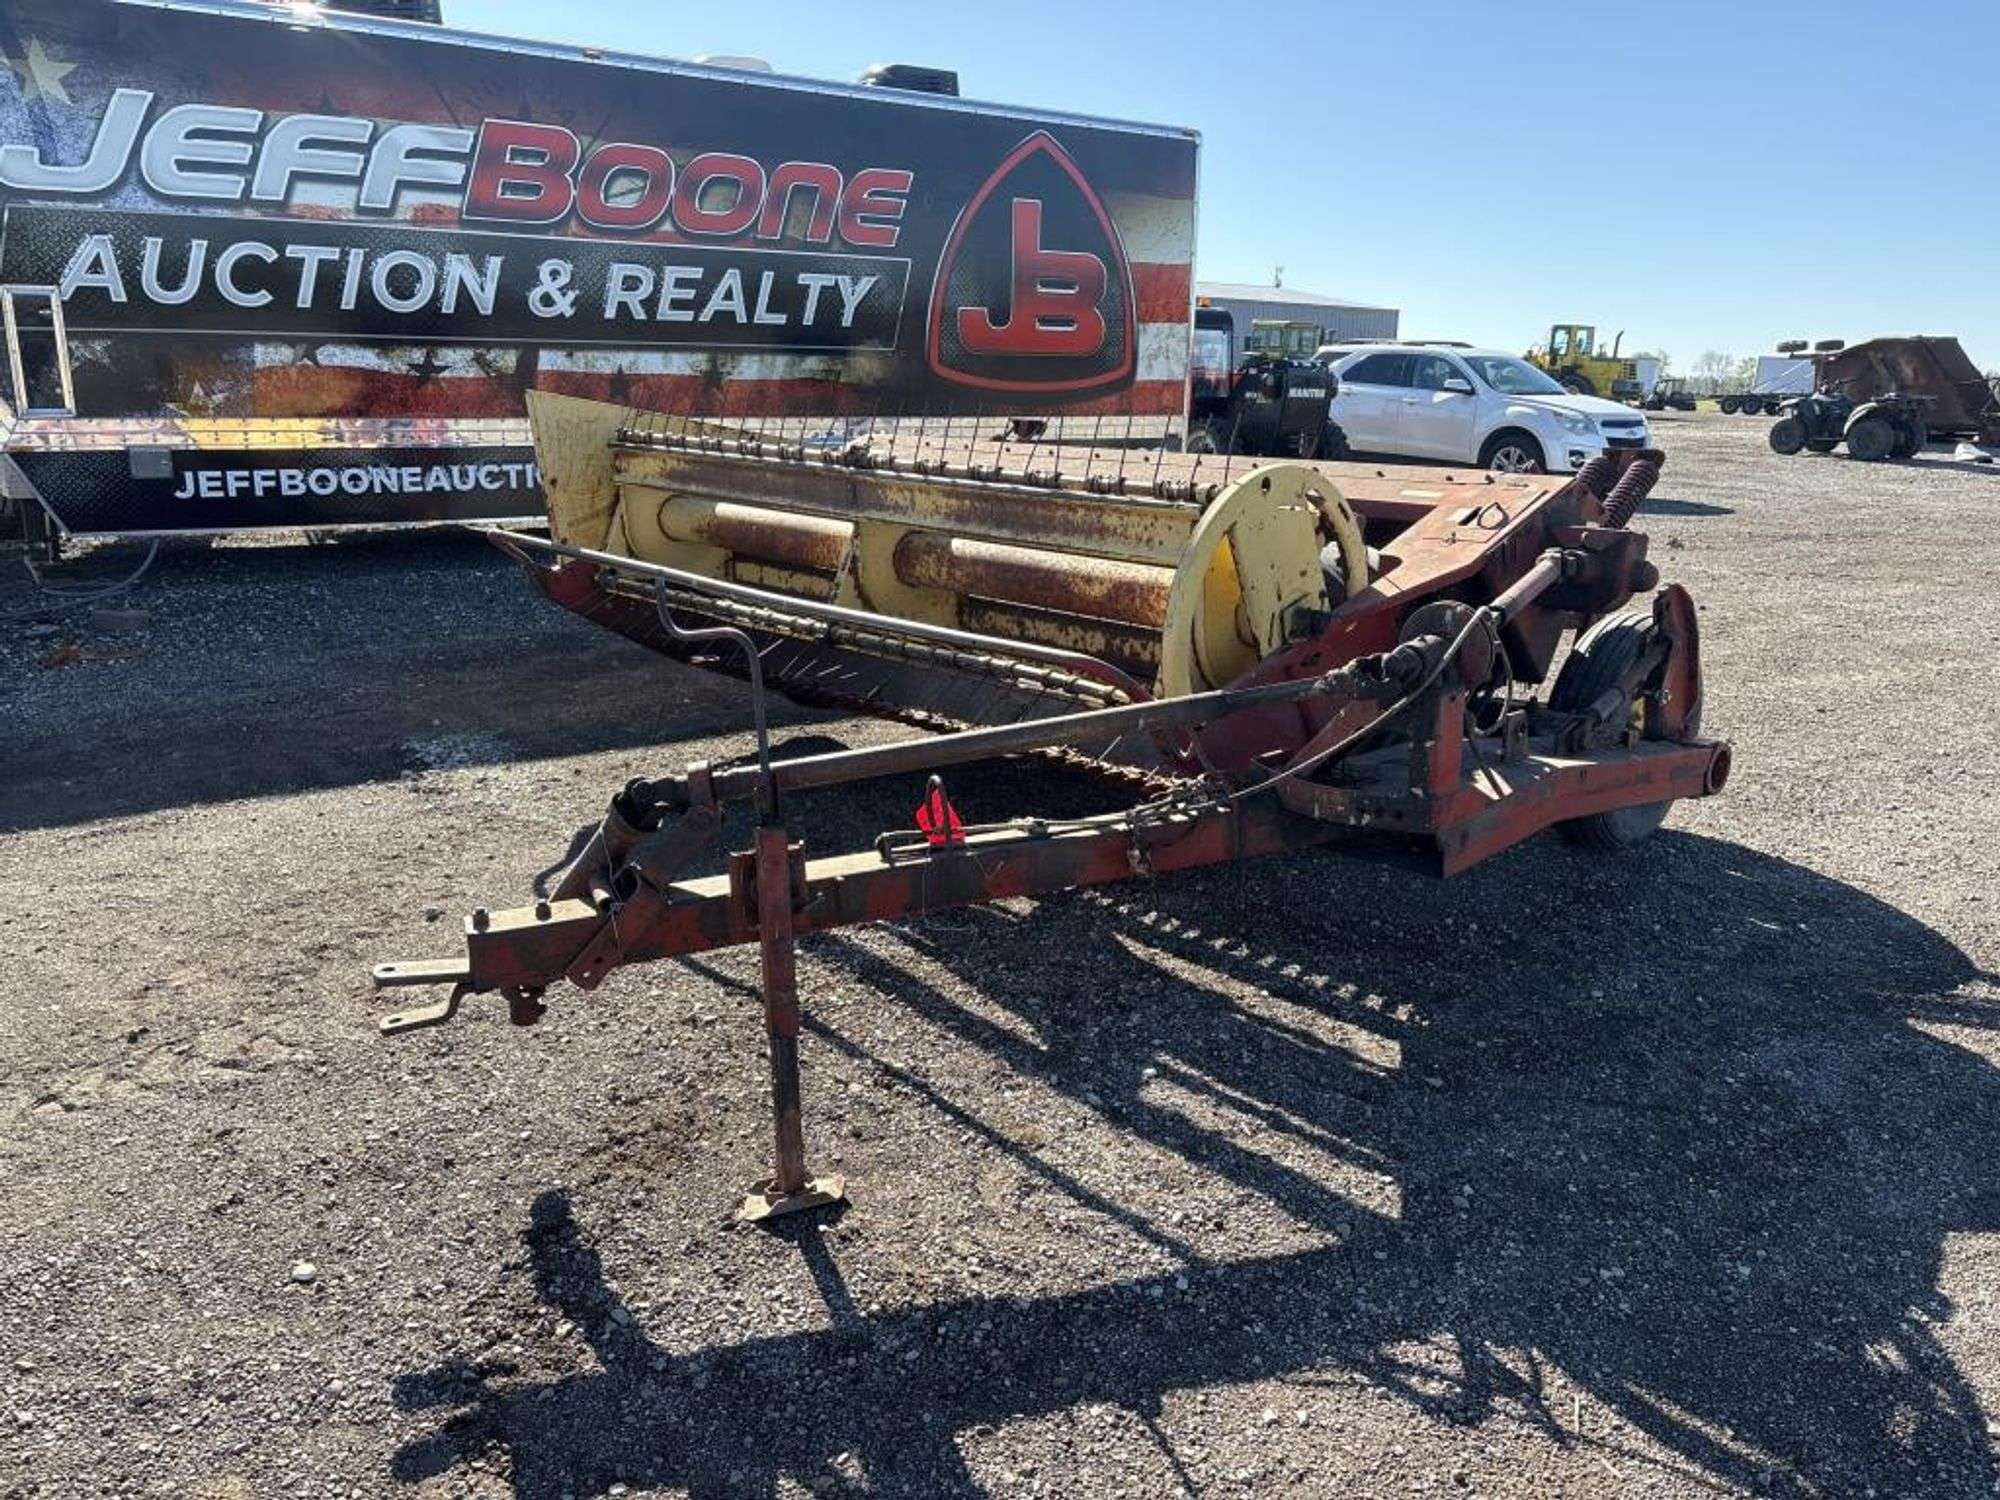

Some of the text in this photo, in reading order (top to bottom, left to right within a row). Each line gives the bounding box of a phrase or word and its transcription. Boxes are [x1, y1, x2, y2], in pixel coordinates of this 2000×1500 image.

[60, 234, 878, 327] AUCTION & REALTY
[175, 464, 541, 499] JEFFBOONEAUCTI
